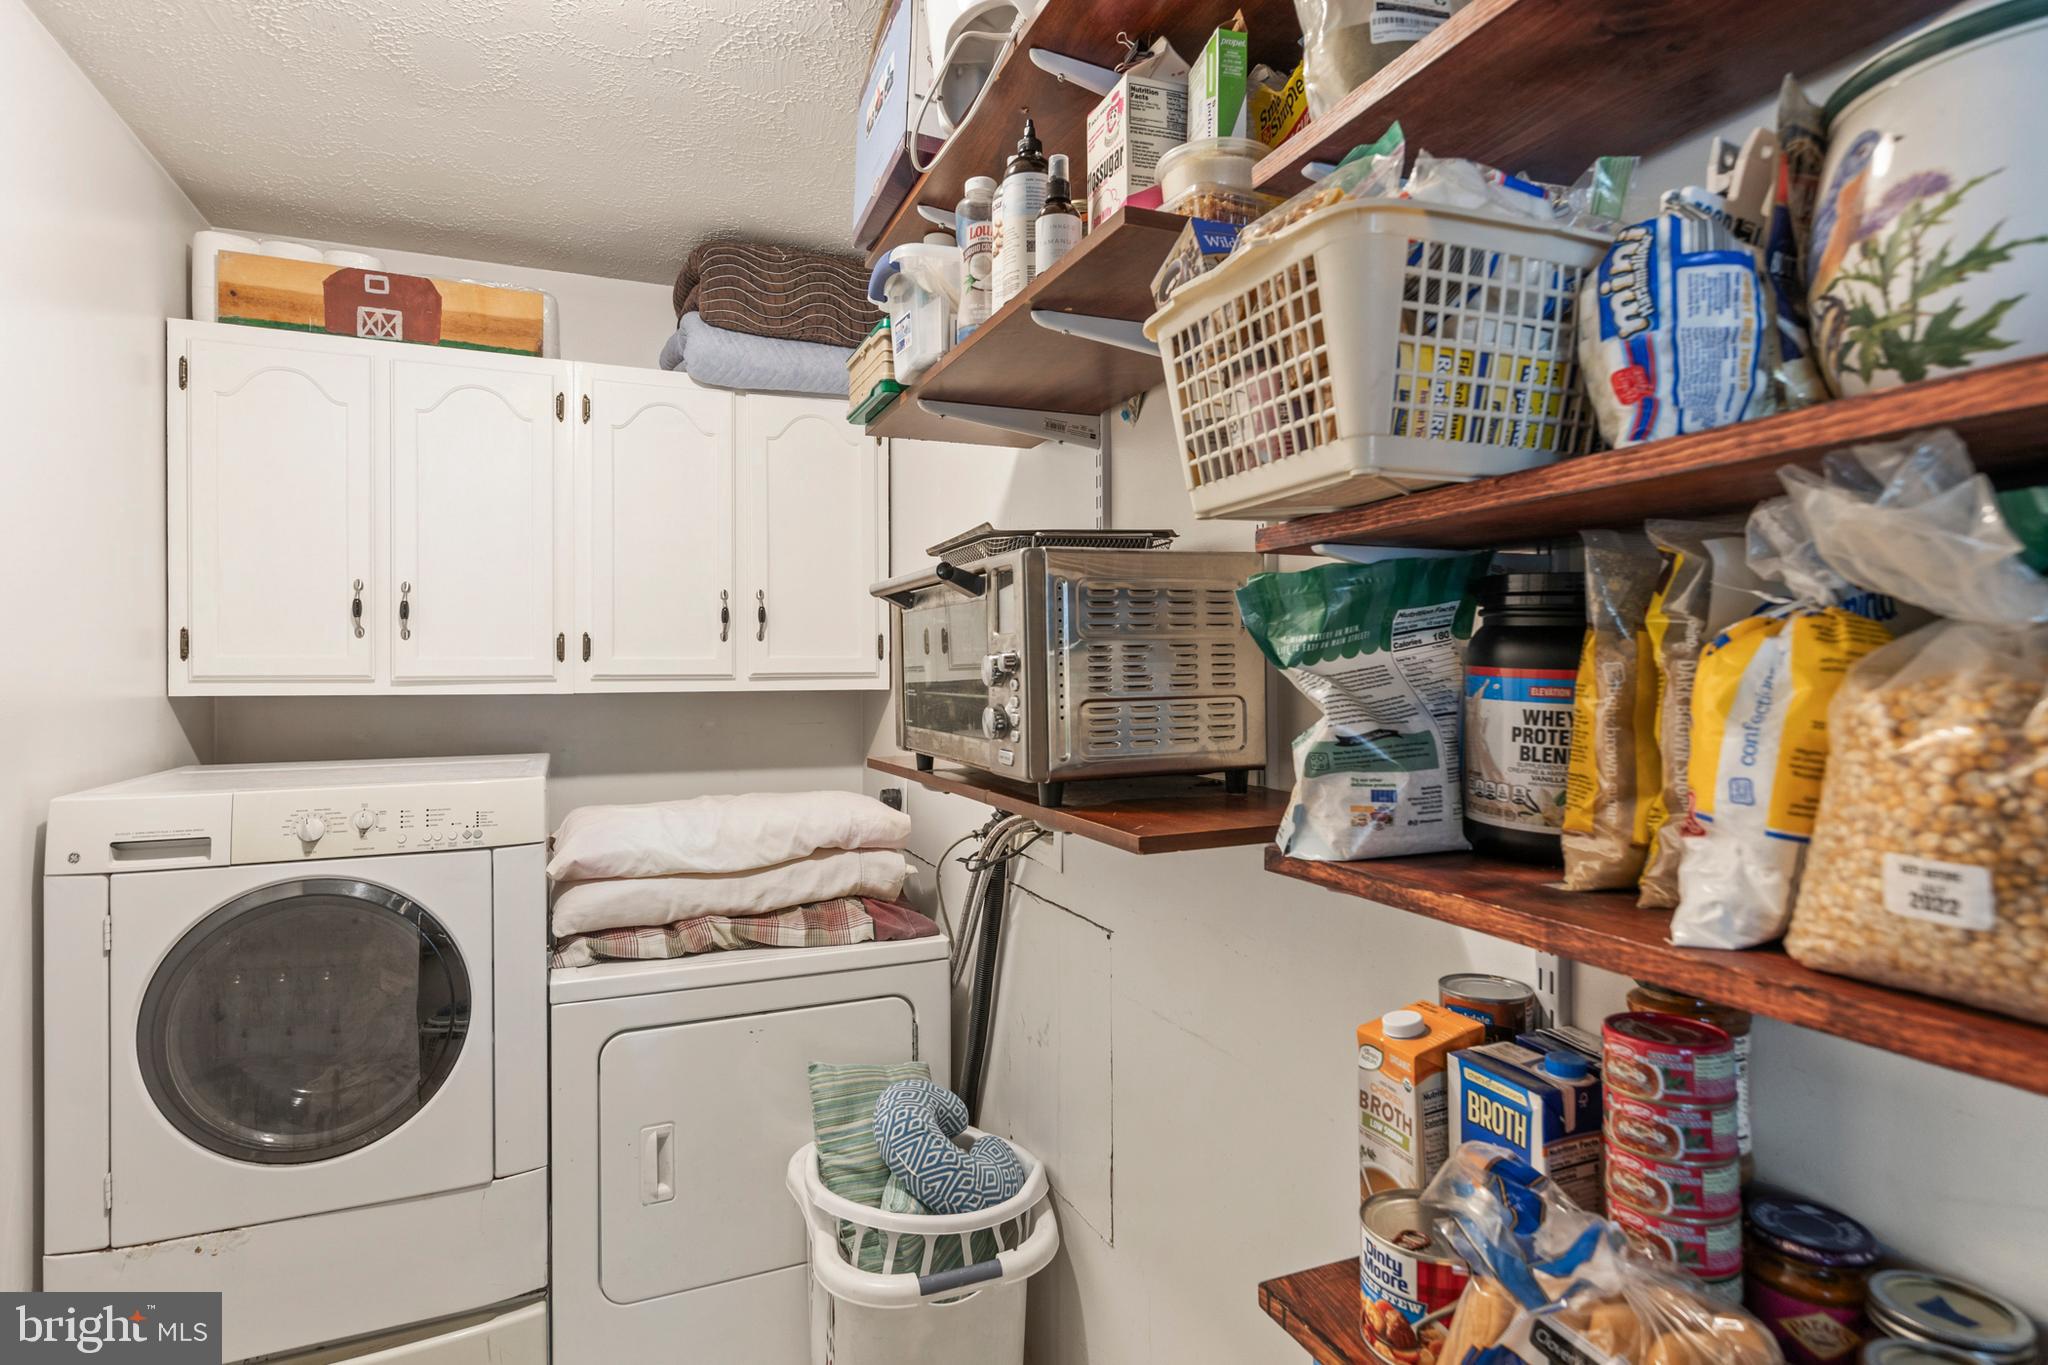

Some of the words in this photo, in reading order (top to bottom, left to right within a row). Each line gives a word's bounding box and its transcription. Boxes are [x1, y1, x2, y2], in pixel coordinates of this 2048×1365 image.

[1130, 86, 1159, 97] Nutrition
[1130, 92, 1149, 101] Facts
[1271, 78, 1305, 138] Simple
[1599, 225, 1650, 340] mini
[1397, 609, 1434, 618] Nutrition
[1435, 605, 1457, 613] Facts
[1393, 639, 1422, 649] Calories
[1530, 687, 1571, 697] ELEVATION
[1676, 659, 1696, 700] DARK
[1522, 709, 1574, 728] WHEY
[1674, 705, 1691, 762] BROWN
[1605, 726, 1621, 776] brown
[1531, 775, 1567, 784] VANILLA
[1359, 1089, 1413, 1137] BROTH
[1467, 1089, 1527, 1149] BROTH
[1363, 1251, 1411, 1294] Moore
[1365, 1237, 1403, 1278] Dinty
[1381, 1289, 1422, 1315] STEW
